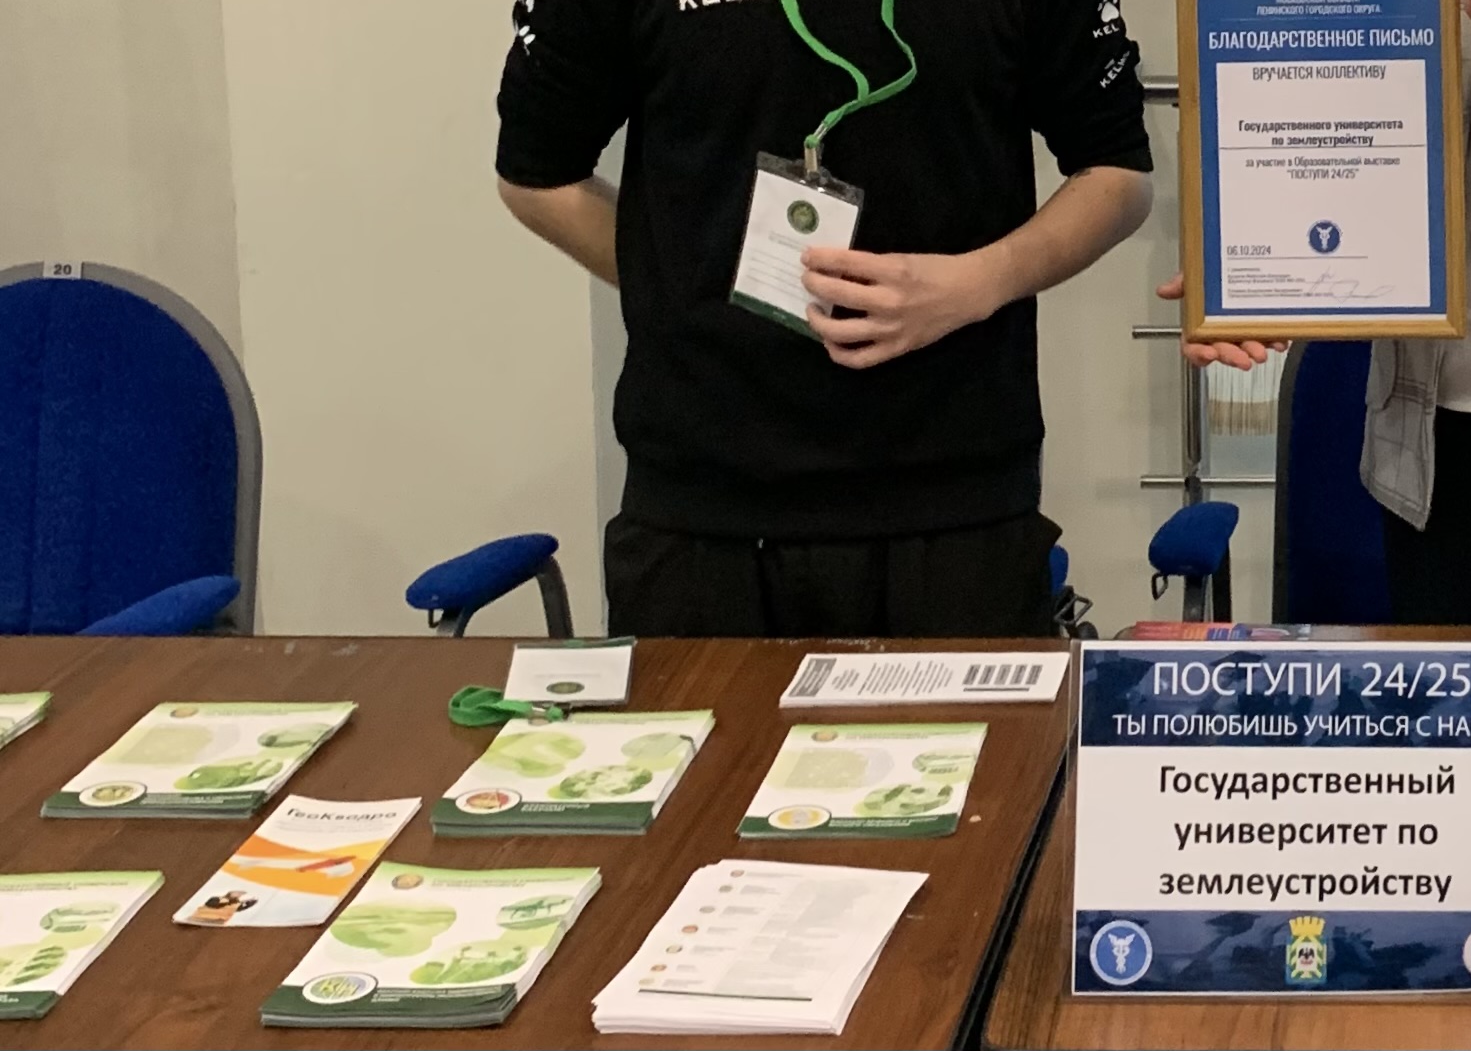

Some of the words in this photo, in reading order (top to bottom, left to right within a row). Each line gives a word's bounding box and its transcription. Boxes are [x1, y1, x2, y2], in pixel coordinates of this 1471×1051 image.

[1208, 29, 1365, 51] БЛАГОДАРСТВЕННОЕ
[1369, 28, 1435, 47] ПИСЬМО
[1252, 65, 1314, 82] ВРУЧАЕТСЯ
[1315, 64, 1387, 80] КОЛЛЕКТИВУ
[1238, 119, 1332, 134] Государственного
[1333, 120, 1404, 132] университета
[1271, 136, 1285, 146] по
[1286, 133, 1374, 148] землеустройству
[1226, 244, 1272, 256] 06.10.2024
[53, 263, 73, 276] 20
[1153, 661, 1342, 696] ПОСТУПИ
[1360, 660, 1471, 699] 24/25
[1112, 713, 1146, 736] ТЫ
[1152, 712, 1298, 736] ПОЛЮБИШЬ
[1303, 714, 1410, 737] УЧИТЬСЯ
[1415, 715, 1432, 737] С
[1160, 764, 1455, 801] Государственный
[1174, 822, 1388, 851] университет
[1398, 823, 1439, 845] по
[1159, 866, 1452, 903] землеустройству
